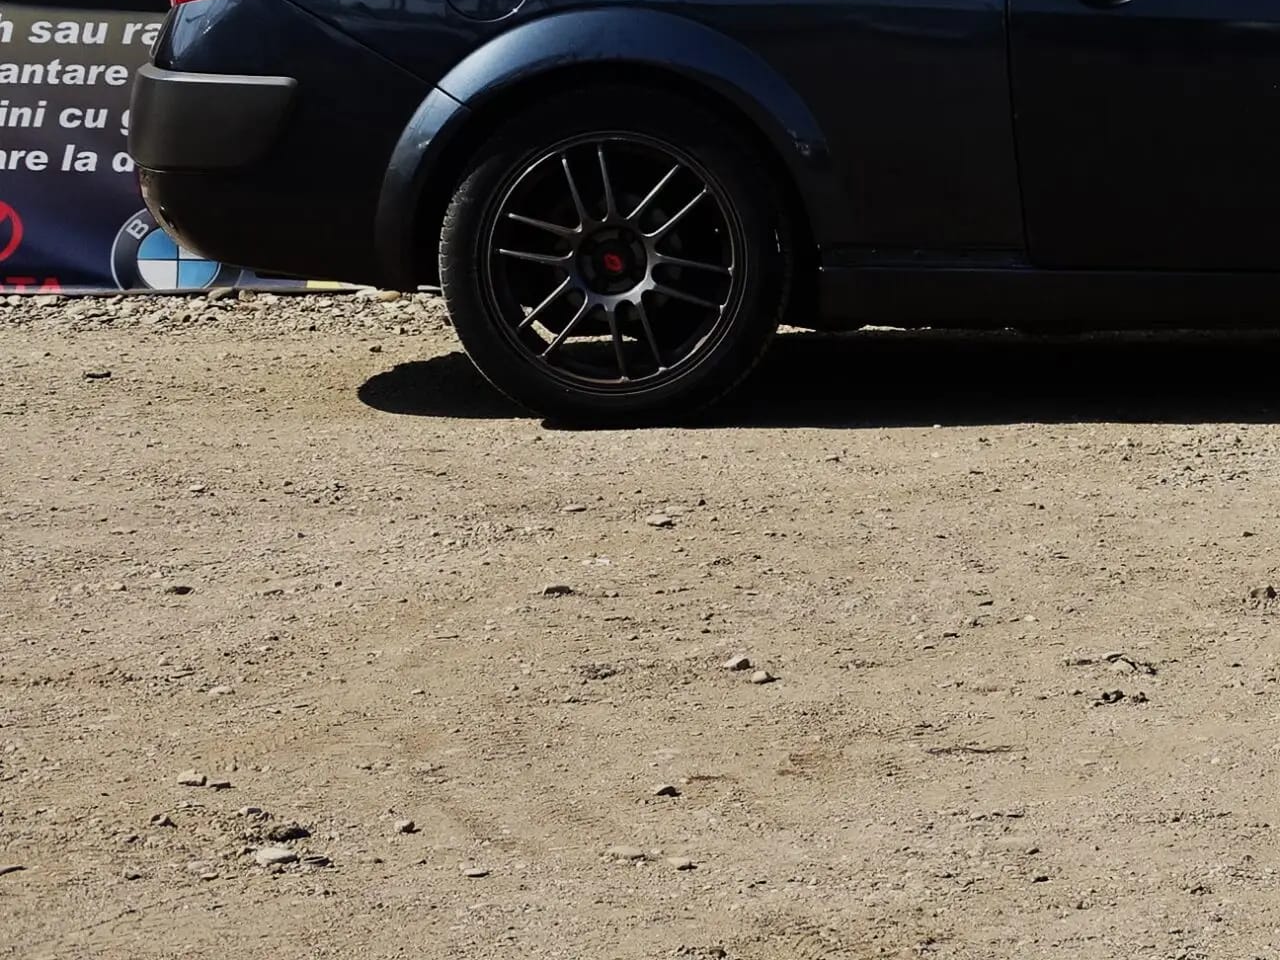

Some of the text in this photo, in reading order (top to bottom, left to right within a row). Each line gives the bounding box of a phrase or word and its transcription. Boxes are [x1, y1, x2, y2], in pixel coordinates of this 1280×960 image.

[28, 19, 109, 44] sau
[59, 107, 108, 129] cu
[0, 149, 48, 171] re
[61, 144, 98, 172] la
